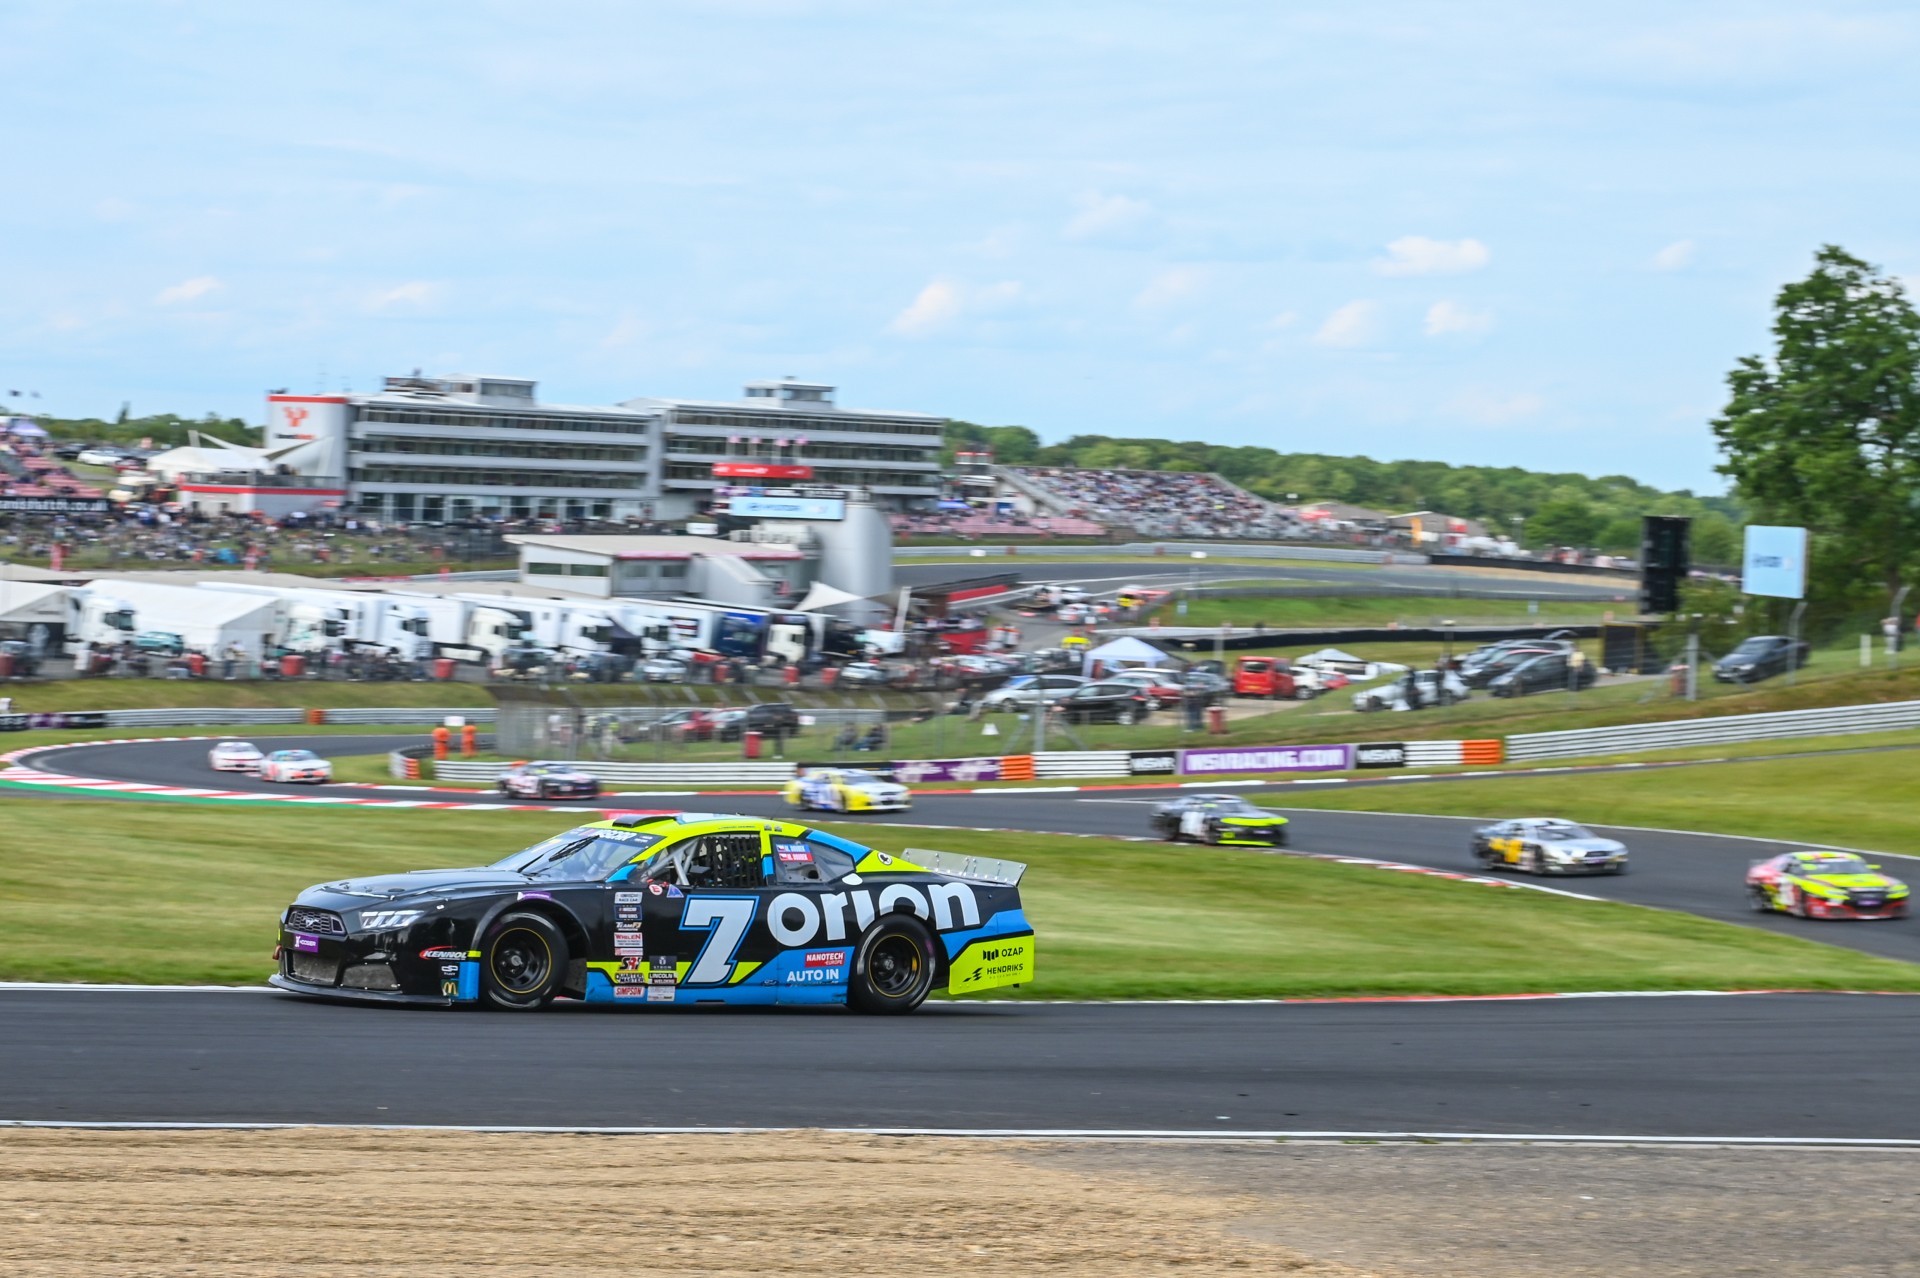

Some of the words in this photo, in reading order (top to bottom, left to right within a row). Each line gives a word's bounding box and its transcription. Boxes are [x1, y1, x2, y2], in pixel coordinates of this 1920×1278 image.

[767, 874, 980, 947] orion
[679, 895, 760, 988] 7
[423, 950, 467, 958] KENNOL
[806, 952, 844, 961] NANOTECH
[1001, 947, 1024, 957] OZAP
[787, 969, 823, 982] AUTO
[826, 968, 839, 980] IN
[987, 963, 1024, 975] HENDRIKS
